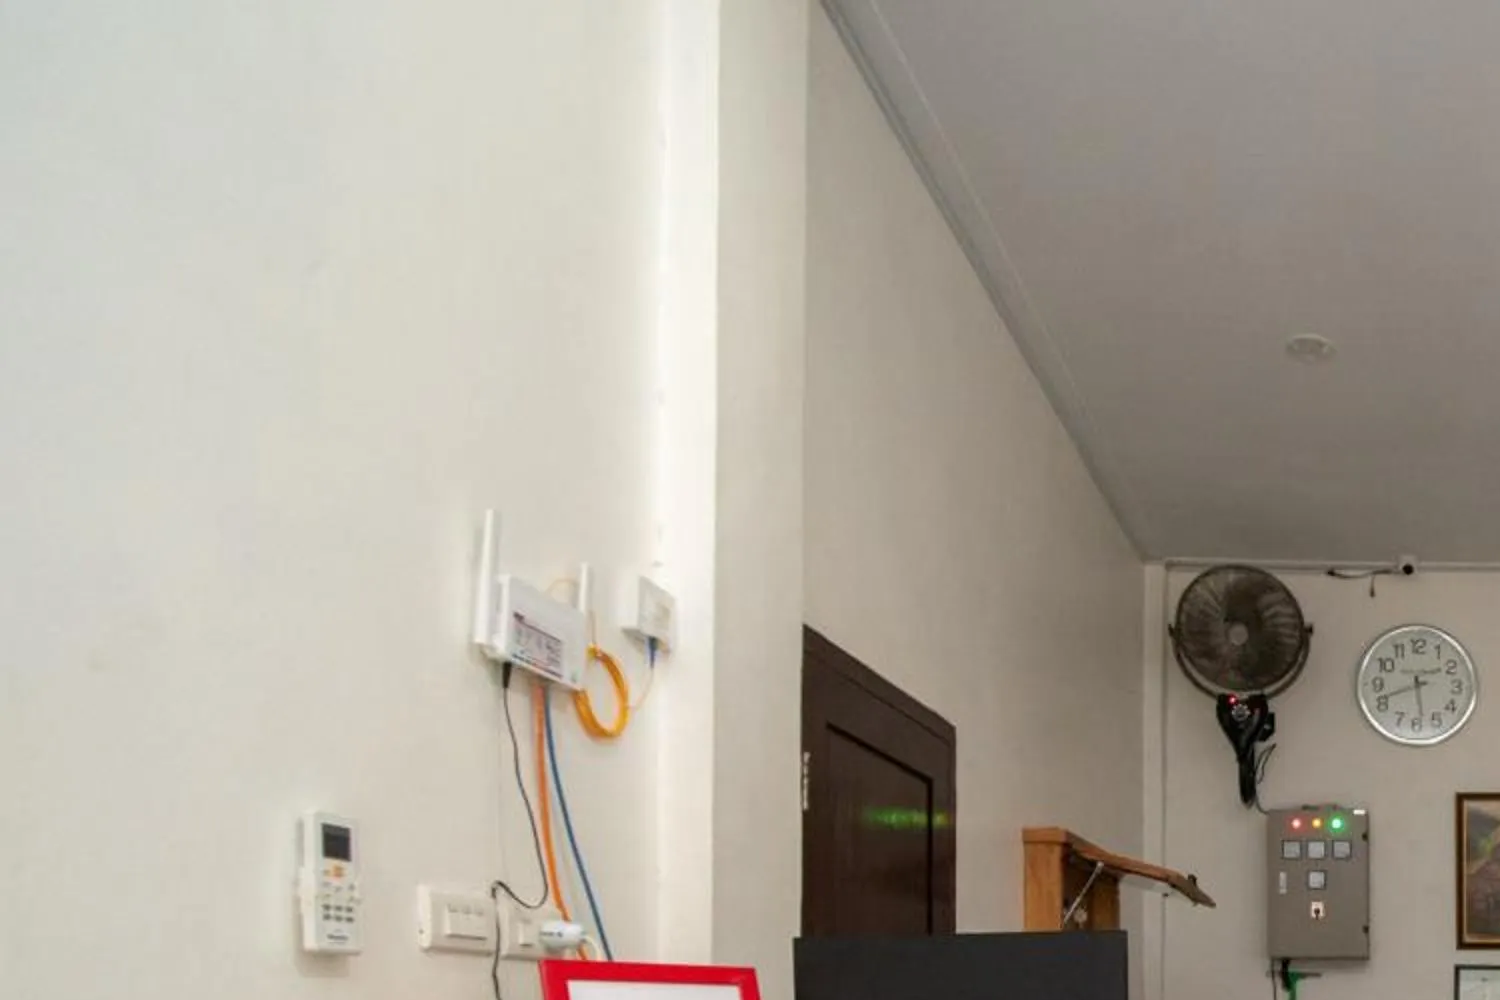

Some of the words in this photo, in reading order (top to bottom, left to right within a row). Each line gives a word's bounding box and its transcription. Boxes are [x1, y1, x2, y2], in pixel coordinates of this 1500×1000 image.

[1393, 643, 1405, 659] 11
[1410, 638, 1427, 655] 12
[1377, 657, 1395, 673] 10
[1445, 658, 1457, 675] 2
[1371, 677, 1384, 693] 9
[1450, 679, 1462, 695] 3
[1376, 694, 1389, 712] 8
[1444, 699, 1457, 713] 4
[1395, 711, 1405, 727] 7
[1411, 718, 1422, 733] 6
[1431, 712, 1443, 728] 5
